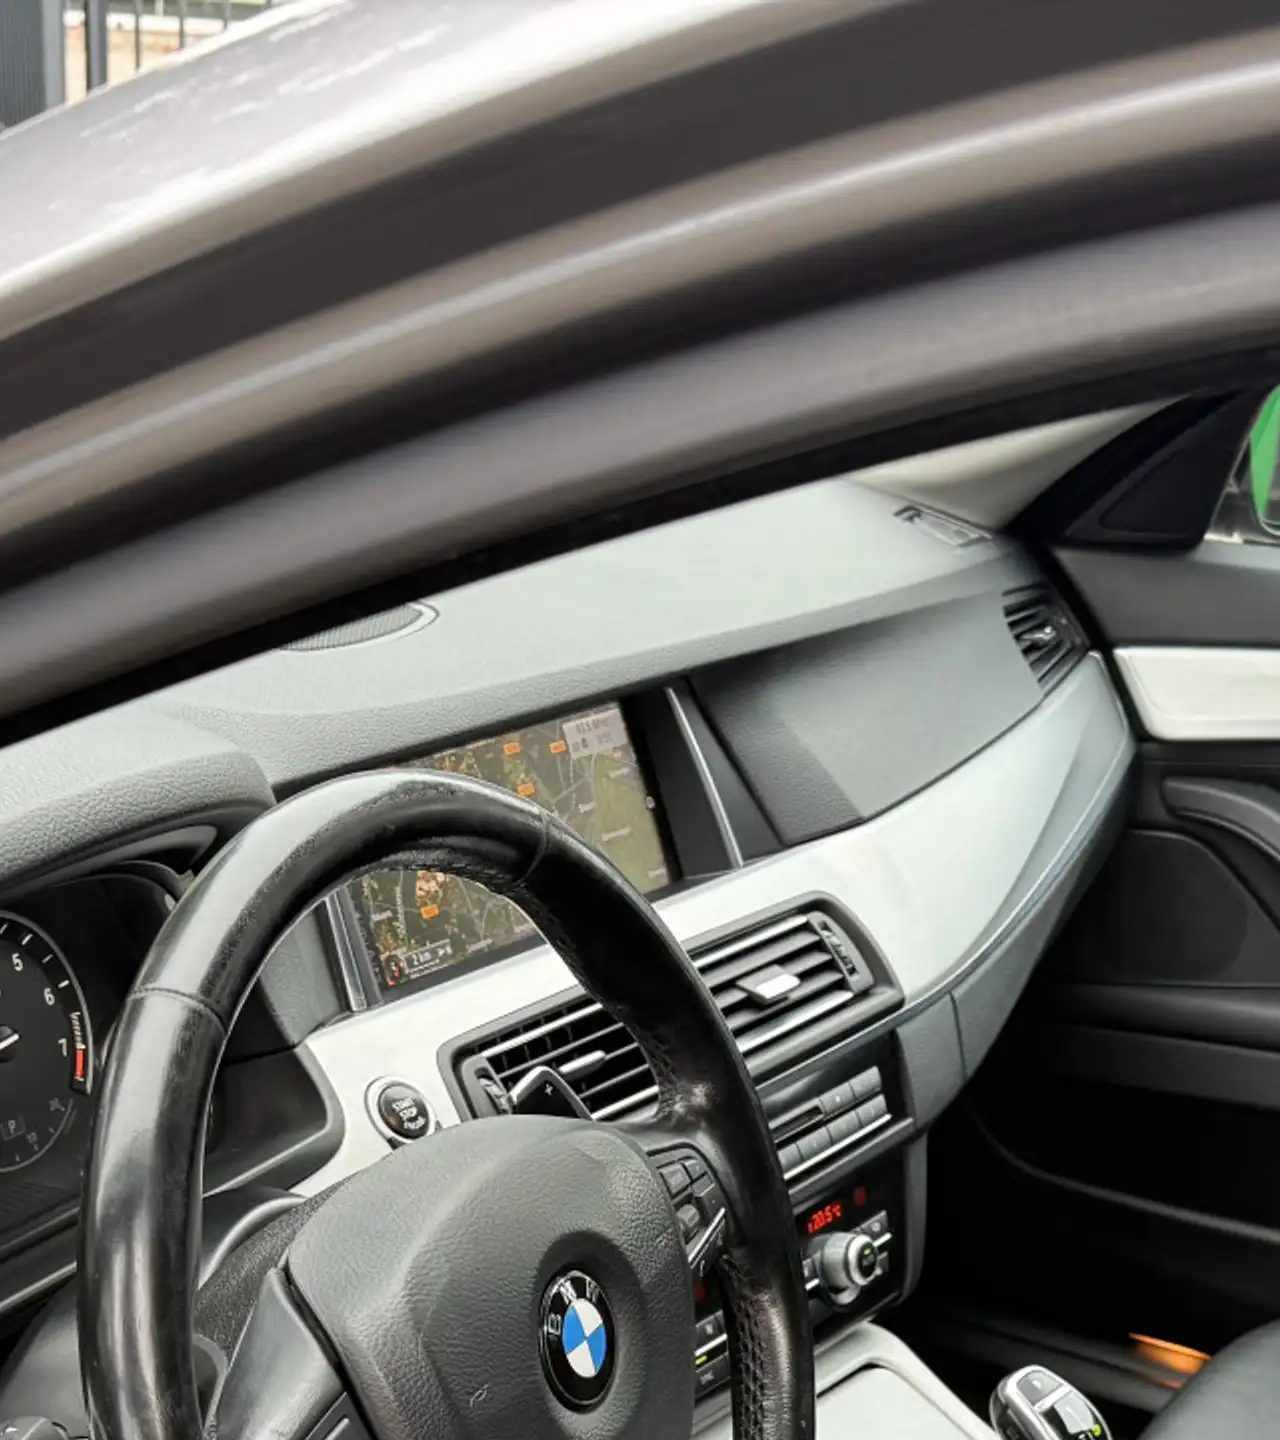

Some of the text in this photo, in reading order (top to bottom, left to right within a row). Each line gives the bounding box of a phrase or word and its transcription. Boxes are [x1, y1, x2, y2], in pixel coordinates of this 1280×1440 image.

[11, 953, 23, 972] 5
[43, 987, 55, 1006] 6
[58, 1038, 69, 1058] 7
[547, 1278, 601, 1336] BMW
